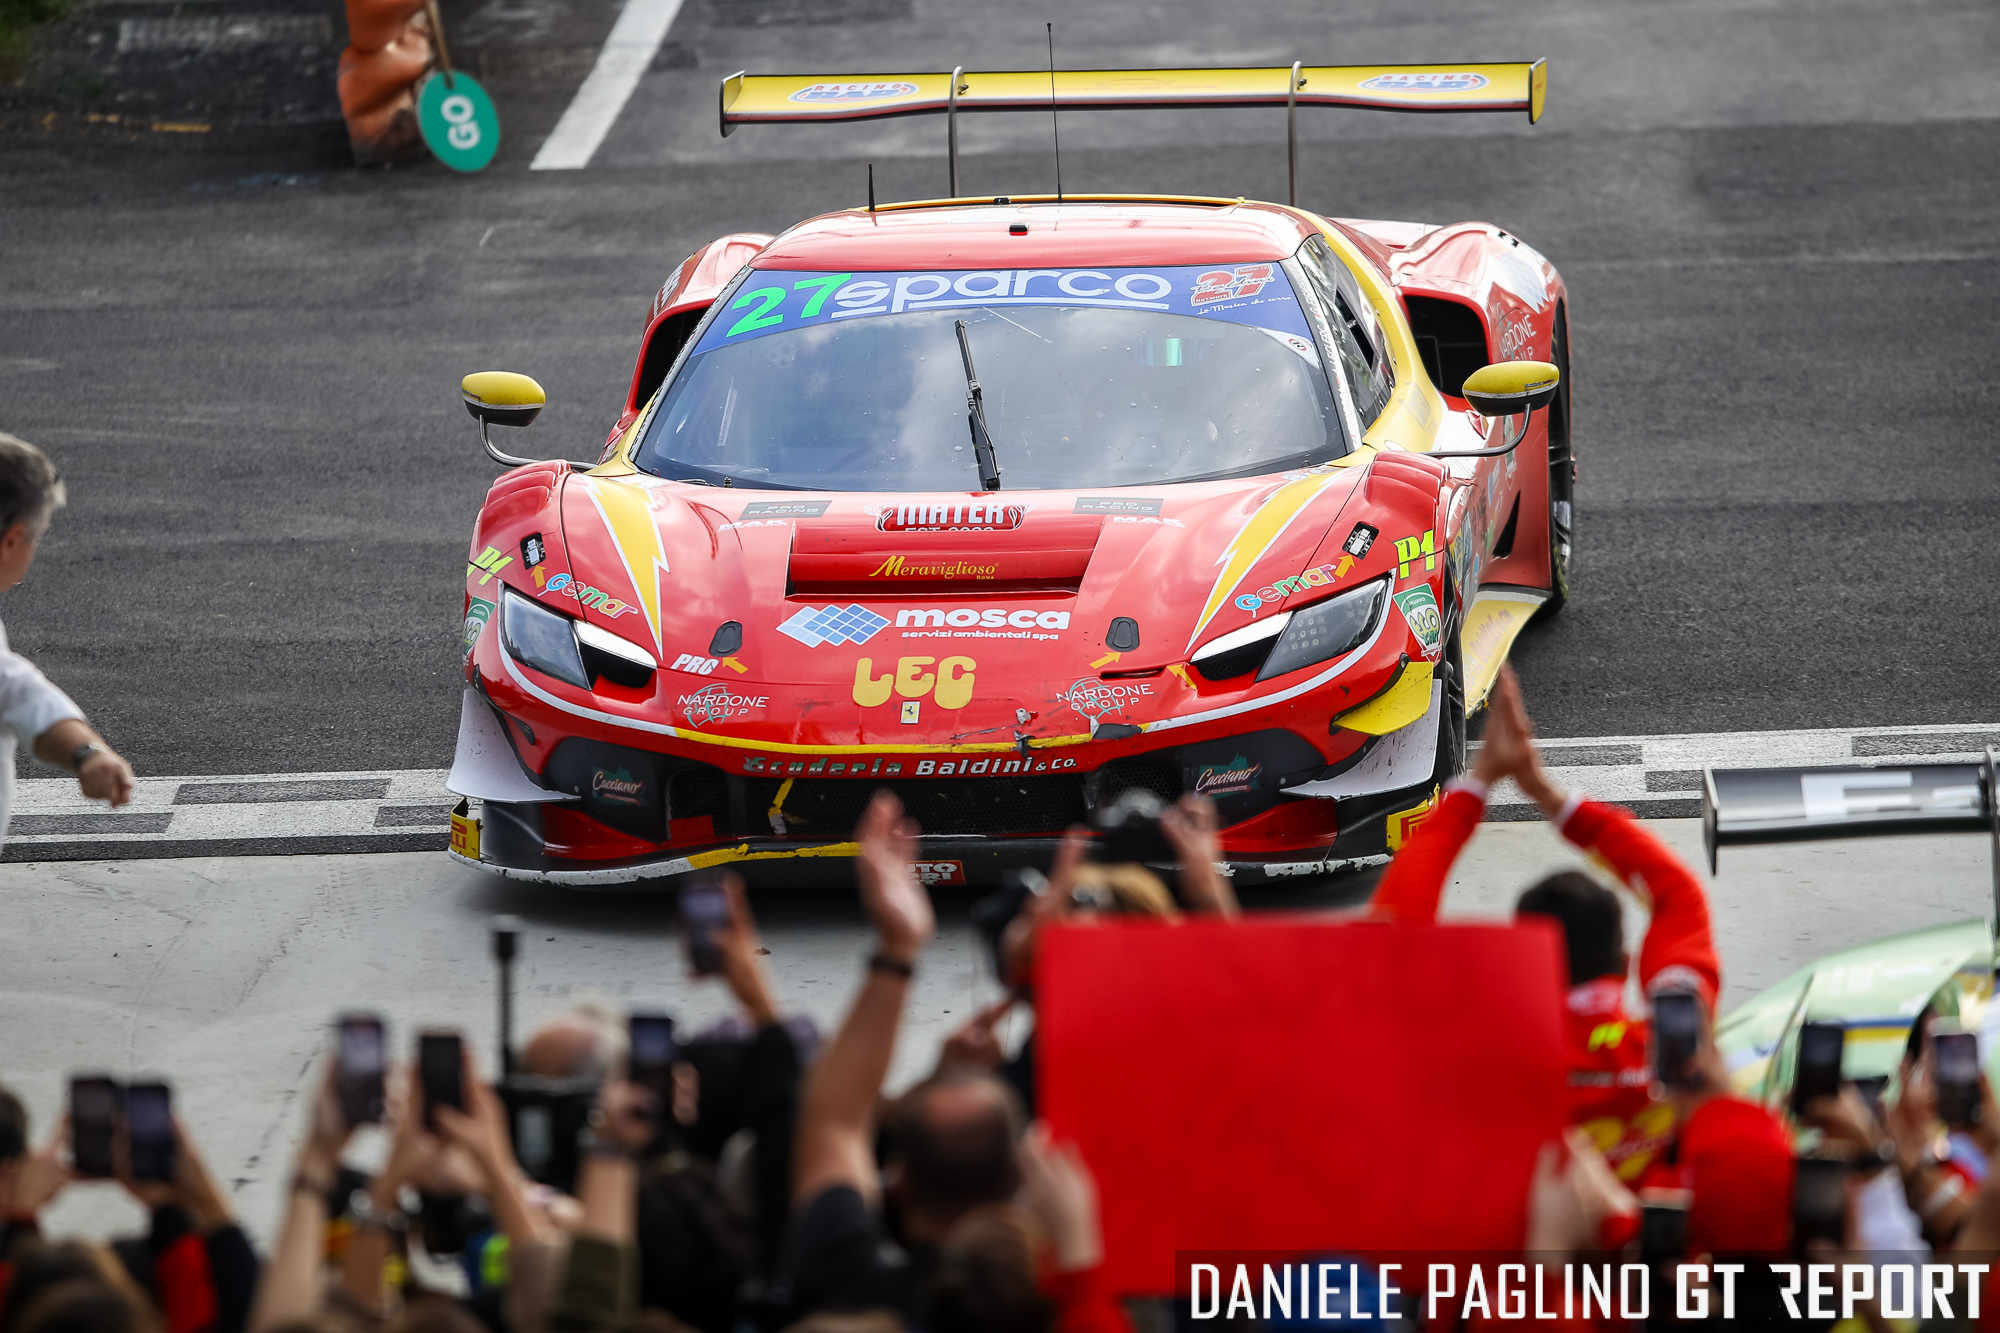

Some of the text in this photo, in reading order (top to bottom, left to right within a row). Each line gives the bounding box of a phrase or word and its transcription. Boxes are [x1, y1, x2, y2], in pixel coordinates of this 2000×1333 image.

[814, 83, 902, 91] RACING
[440, 94, 481, 150] GO
[726, 273, 852, 337] 27
[832, 270, 1172, 316] sparco
[897, 502, 1005, 526] MATER
[1392, 528, 1435, 580] P1
[869, 555, 996, 579] Meraviglioso
[895, 608, 1071, 630] mosca
[901, 629, 1059, 641] servizi ambientali spa
[670, 653, 719, 676] PRO
[677, 694, 770, 708] NARDONE
[1056, 684, 1154, 702] NARDONE
[1071, 697, 1140, 711] GROUP
[683, 706, 749, 716] GROUP
[745, 757, 902, 776] Scuderia
[915, 756, 1034, 776] Baldini
[1196, 763, 1257, 791] Cacciano
[592, 770, 642, 794] Cacciano
